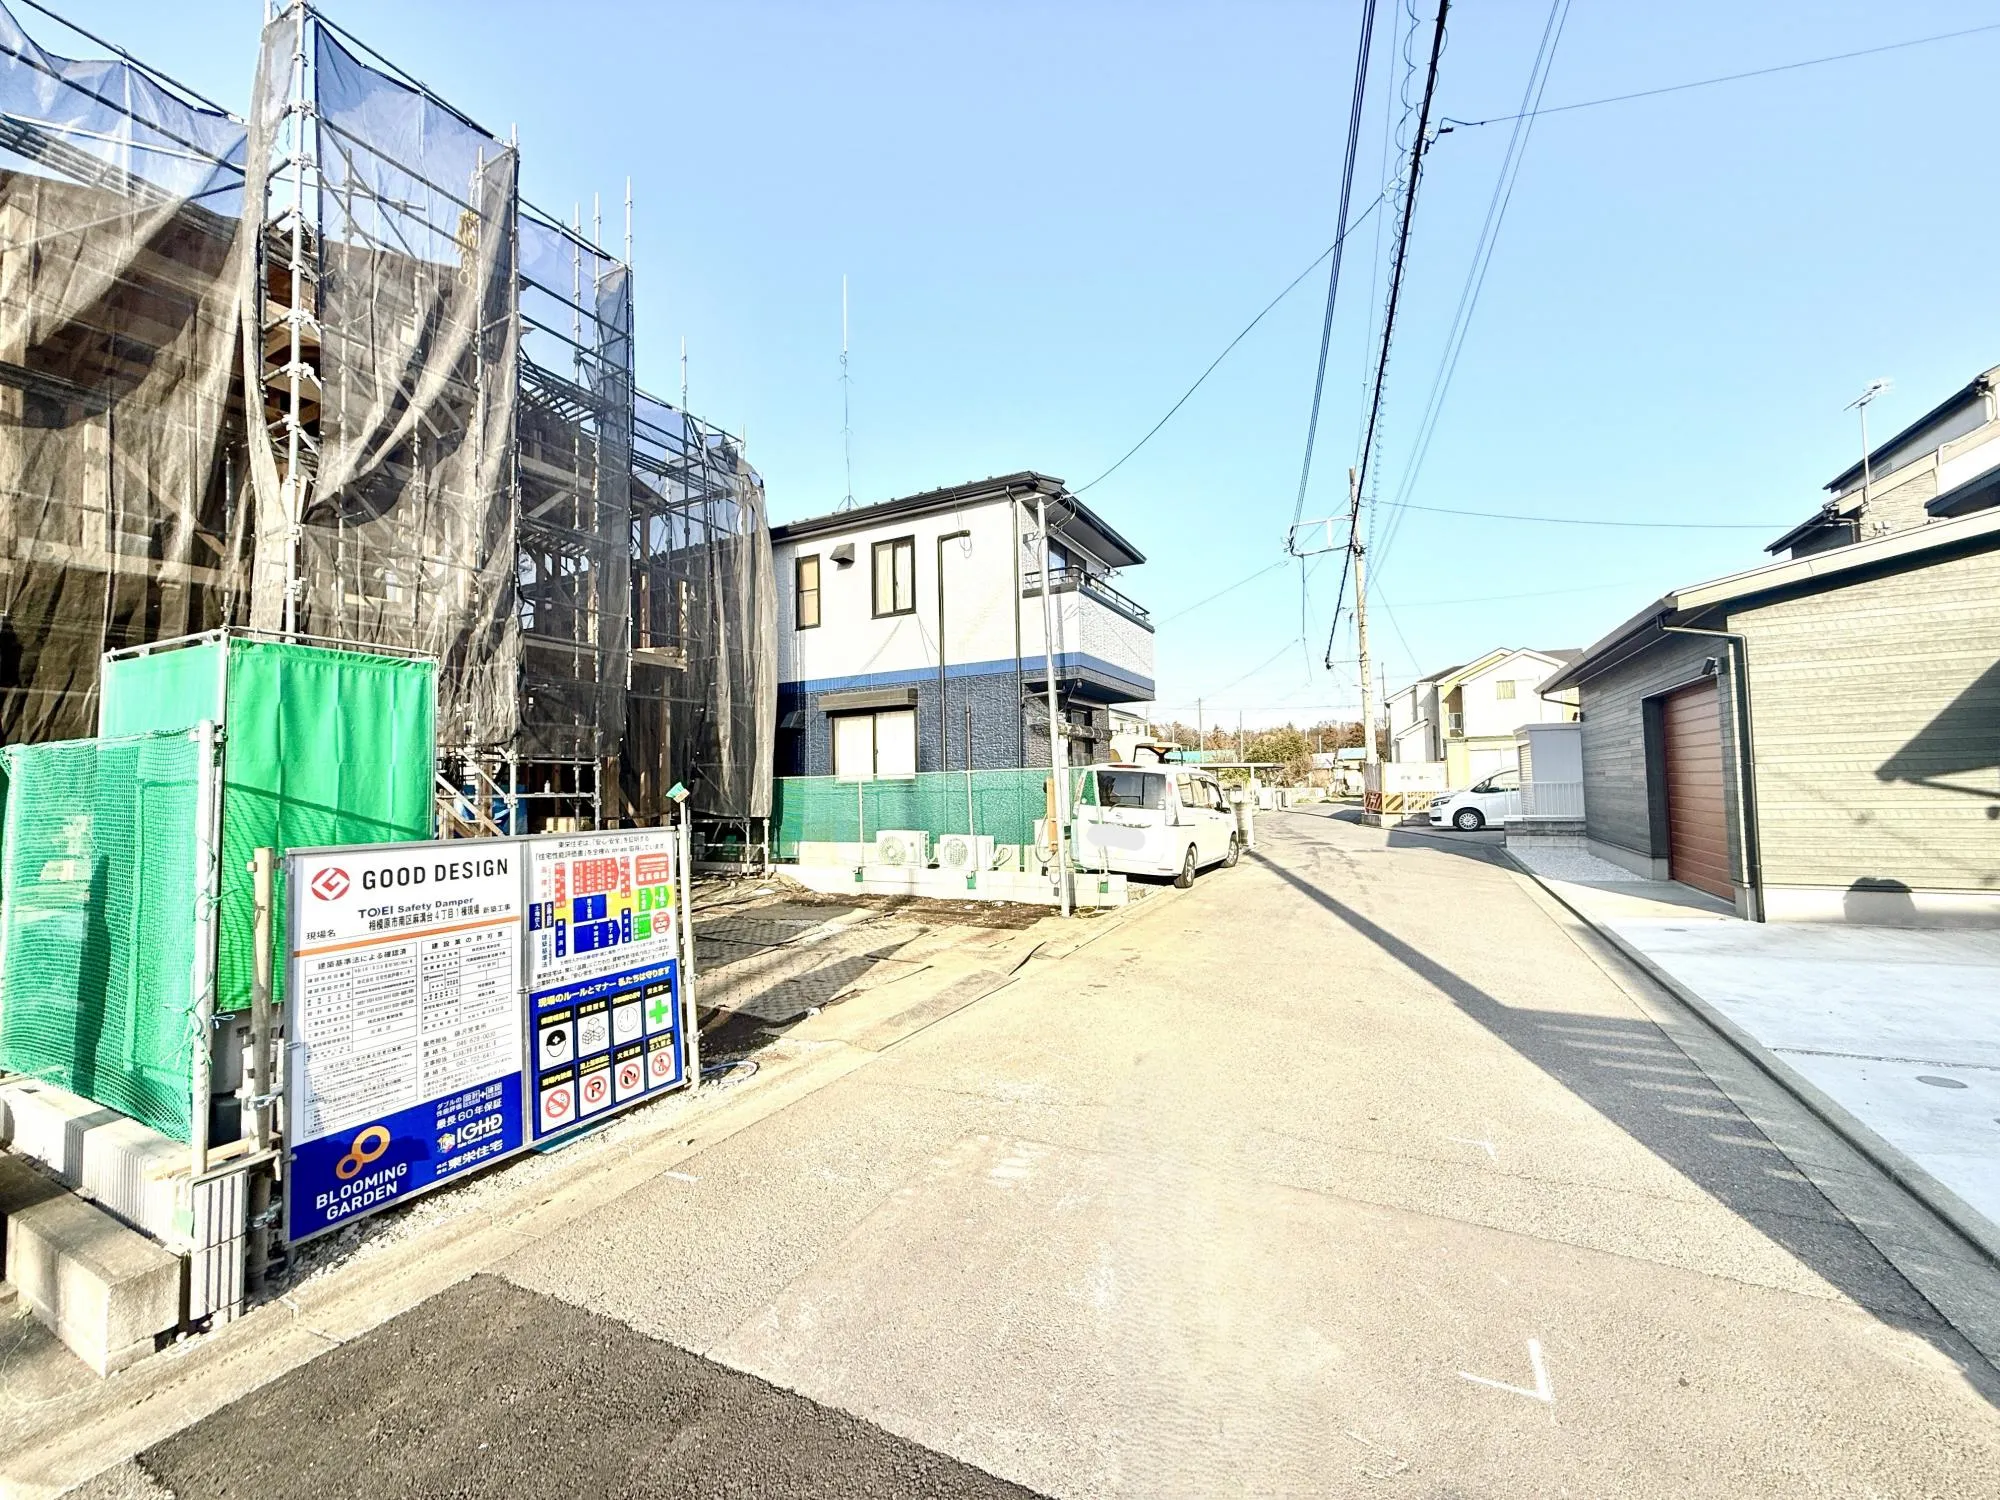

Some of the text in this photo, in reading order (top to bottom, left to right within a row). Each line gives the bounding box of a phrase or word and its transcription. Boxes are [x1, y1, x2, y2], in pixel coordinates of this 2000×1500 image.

[363, 858, 508, 890] GOOD DESIGN
[398, 902, 431, 914] Safety
[436, 896, 473, 909] Damper
[307, 929, 336, 940] 現場名
[538, 982, 616, 1007] 現場のルールとマナー
[437, 1097, 462, 1110] ダブルの
[457, 1113, 503, 1143] IGHD
[448, 1139, 503, 1170] 東栄住宅
[316, 1163, 408, 1210] BLOOMING
[326, 1181, 398, 1220] GARDEN
